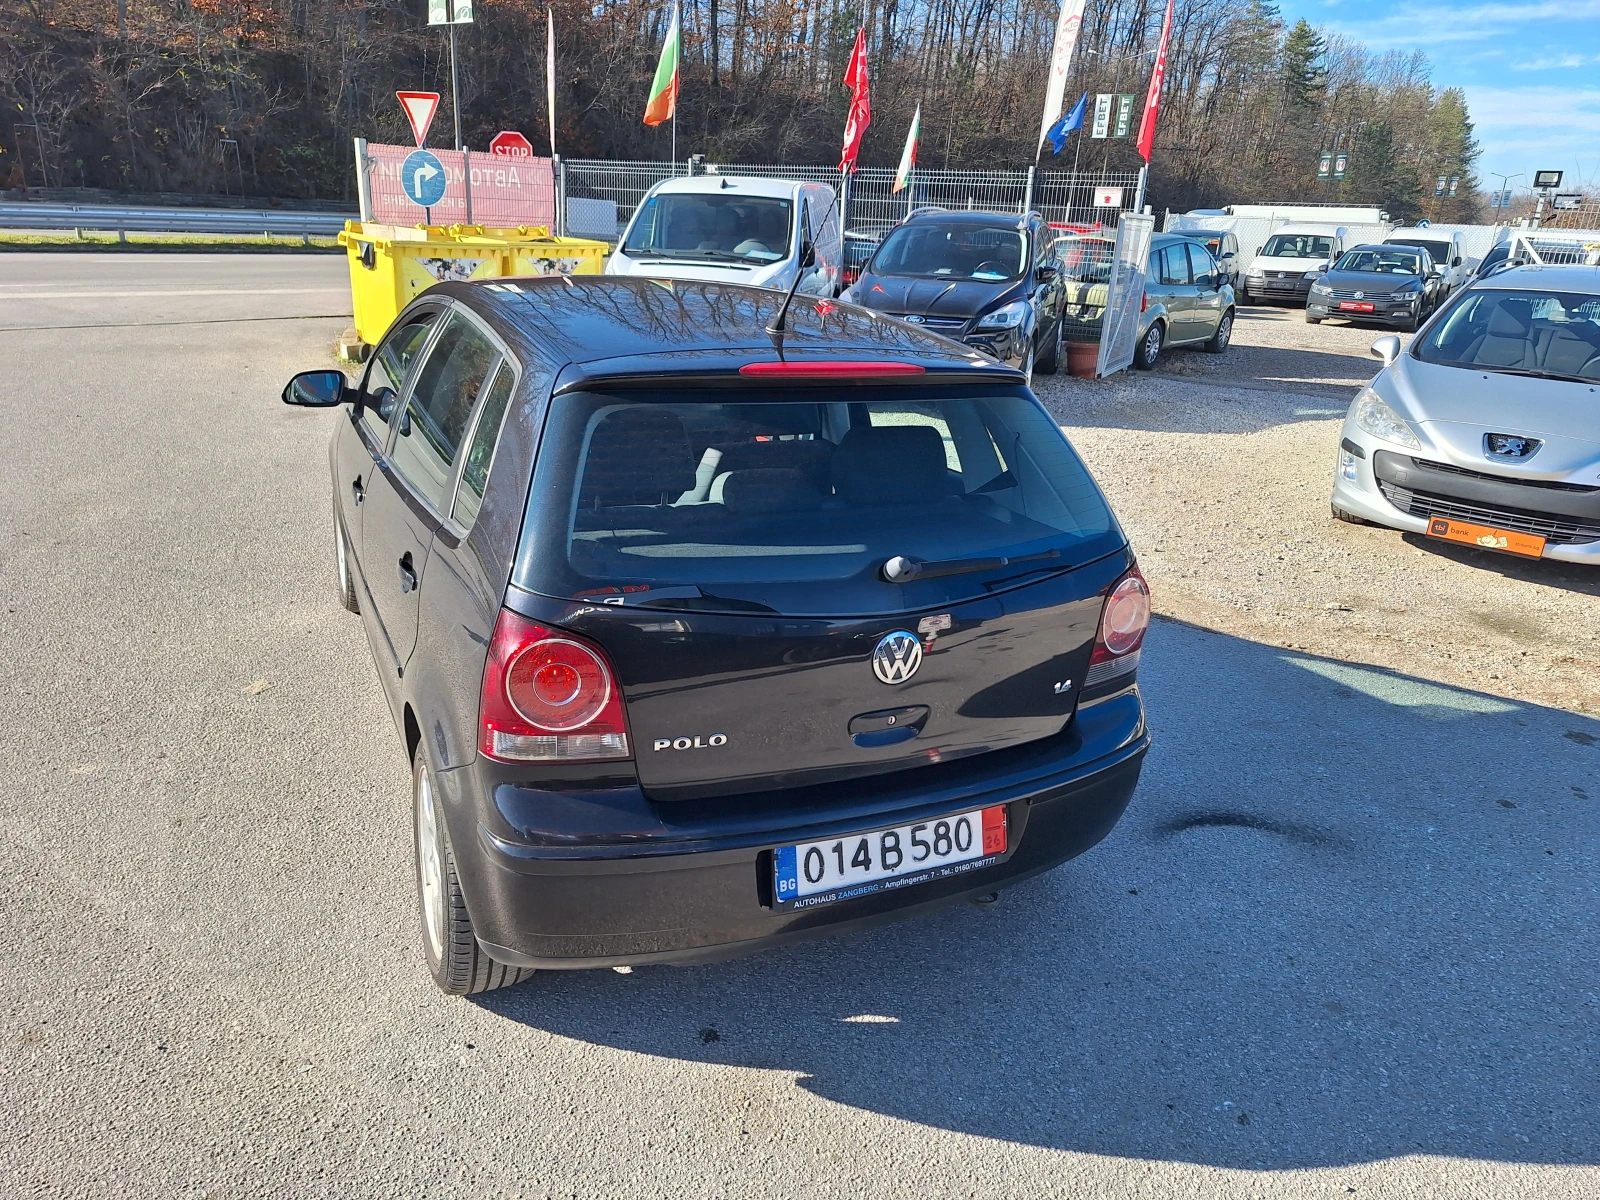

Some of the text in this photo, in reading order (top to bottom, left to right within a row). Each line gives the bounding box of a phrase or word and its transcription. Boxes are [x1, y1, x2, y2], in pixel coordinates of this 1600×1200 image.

[1096, 97, 1108, 136] EFBET
[1117, 97, 1131, 136] EFBET
[495, 145, 528, 157] STOP
[1435, 524, 1470, 536] tbi bank
[653, 732, 728, 752] POLO
[780, 878, 796, 892] BG
[794, 893, 837, 908] AUTOHAUS
[837, 884, 879, 899] ZANGBERG
[884, 873, 930, 888] Ampfingerstr.
